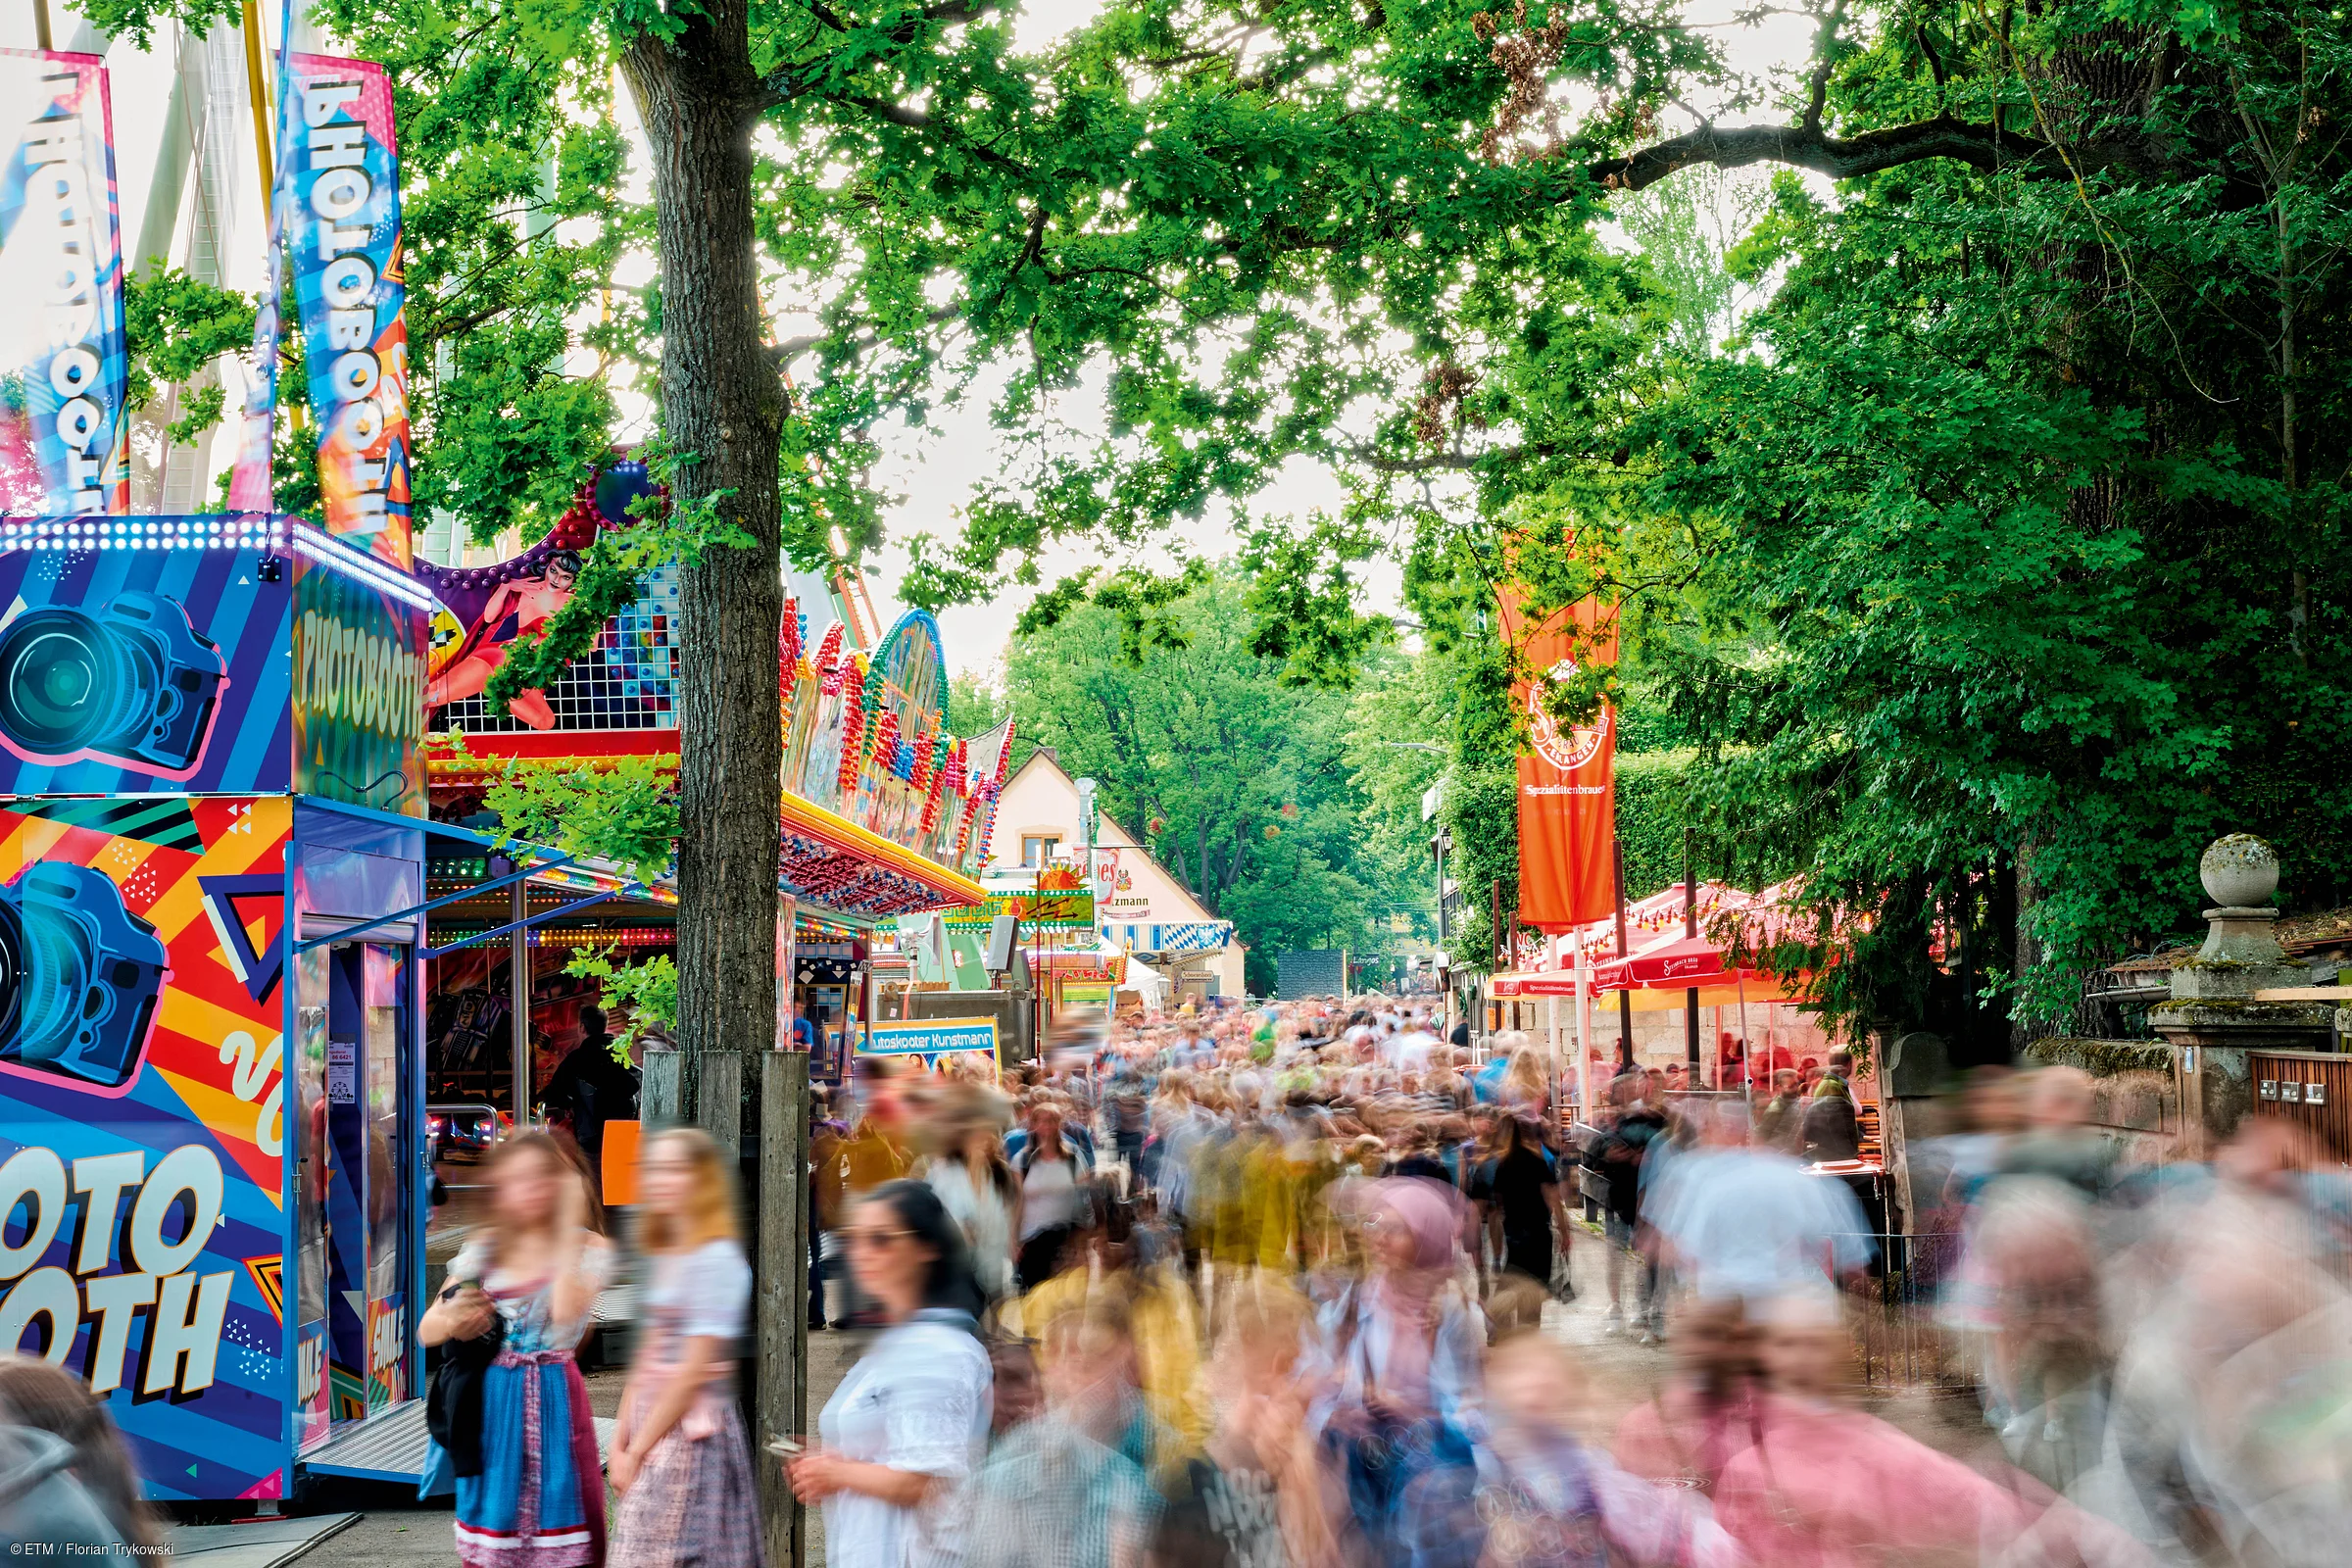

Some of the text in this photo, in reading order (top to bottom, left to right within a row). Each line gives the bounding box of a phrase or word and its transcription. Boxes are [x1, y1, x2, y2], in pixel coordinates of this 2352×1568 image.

[301, 610, 424, 742] PHOTOBOOTH
[872, 1032, 992, 1050] utoskooter Kunstmann
[372, 1304, 405, 1372] SMILE
